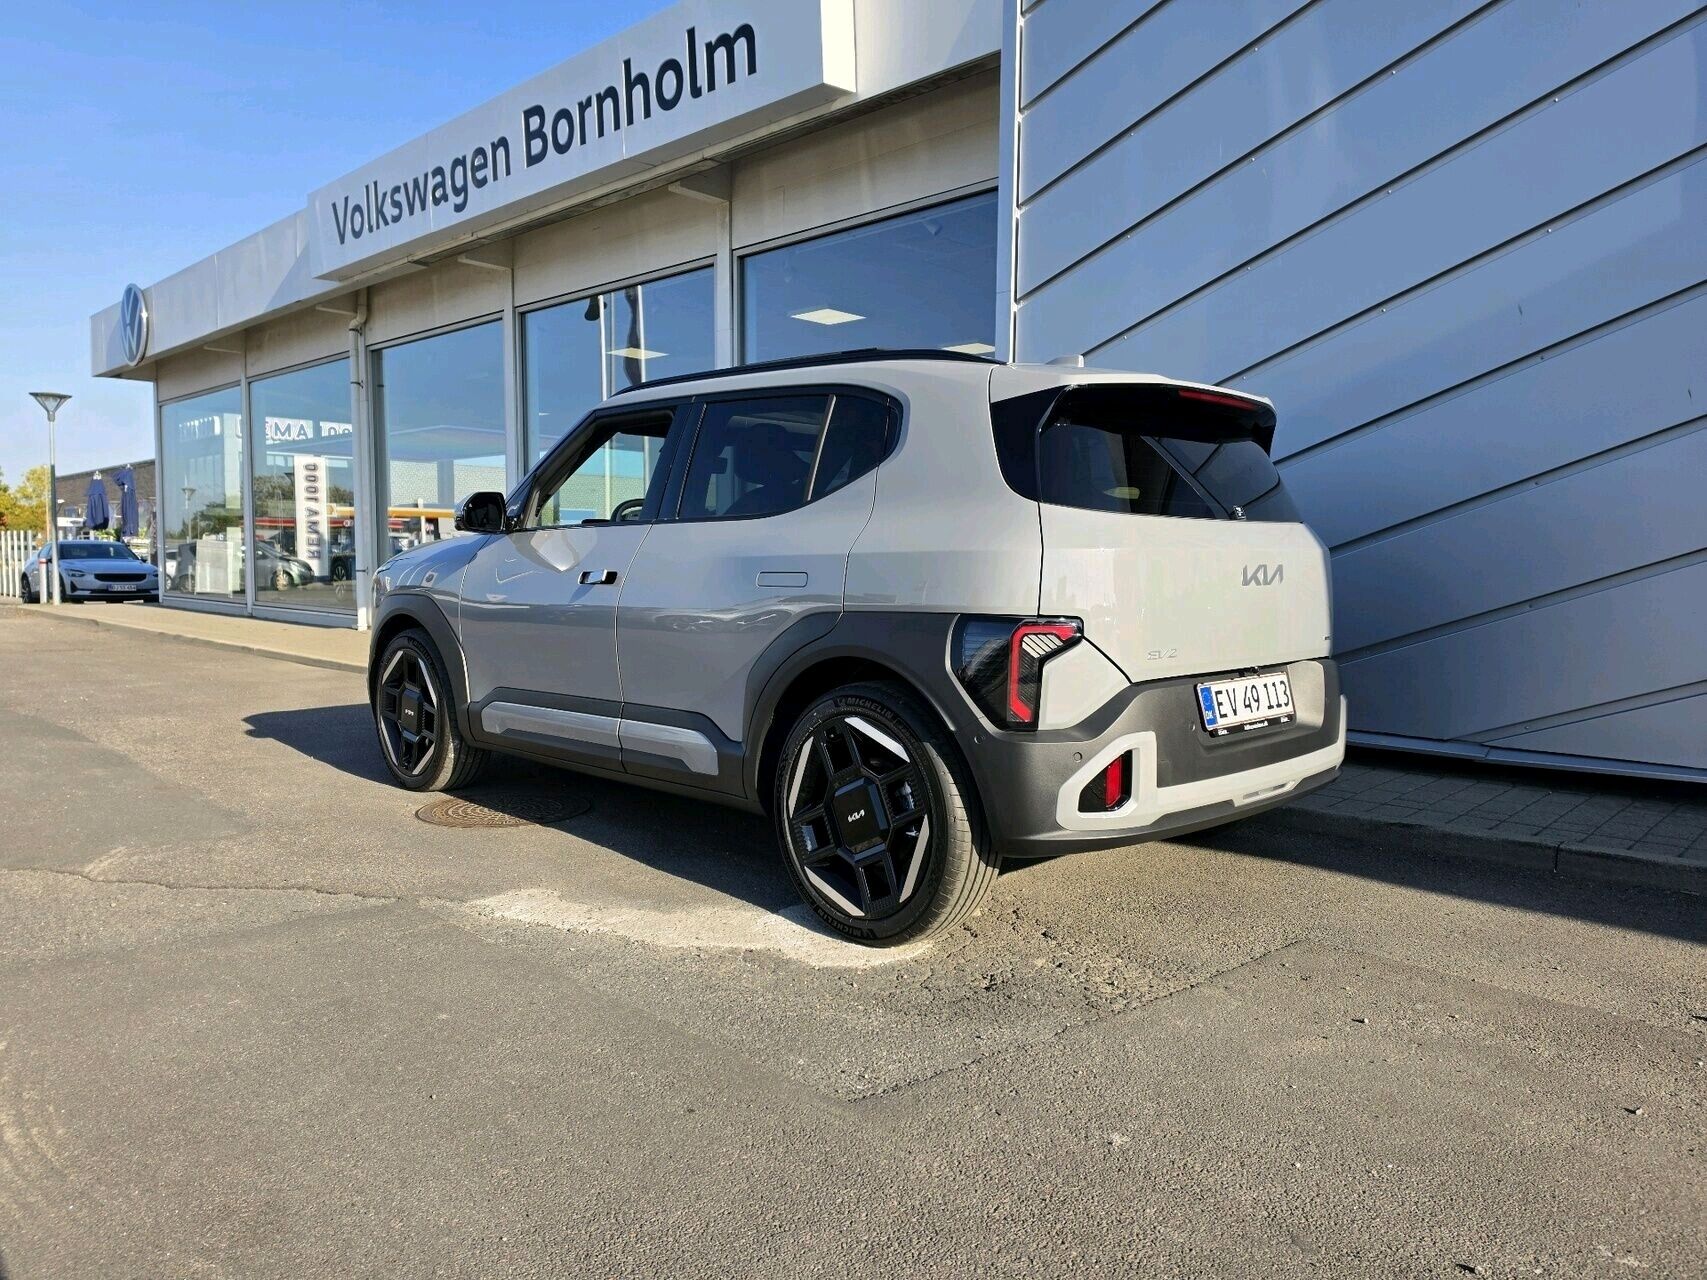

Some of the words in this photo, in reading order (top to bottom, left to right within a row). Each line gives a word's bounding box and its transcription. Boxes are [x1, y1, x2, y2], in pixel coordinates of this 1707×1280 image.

[331, 134, 511, 246] Volkswagen
[522, 22, 757, 169] Bornholm
[1241, 564, 1284, 586] KIA
[847, 697, 895, 720] MICHELIN
[1214, 687, 1238, 718] EV
[1243, 684, 1260, 713] 49
[1263, 680, 1290, 710] 113
